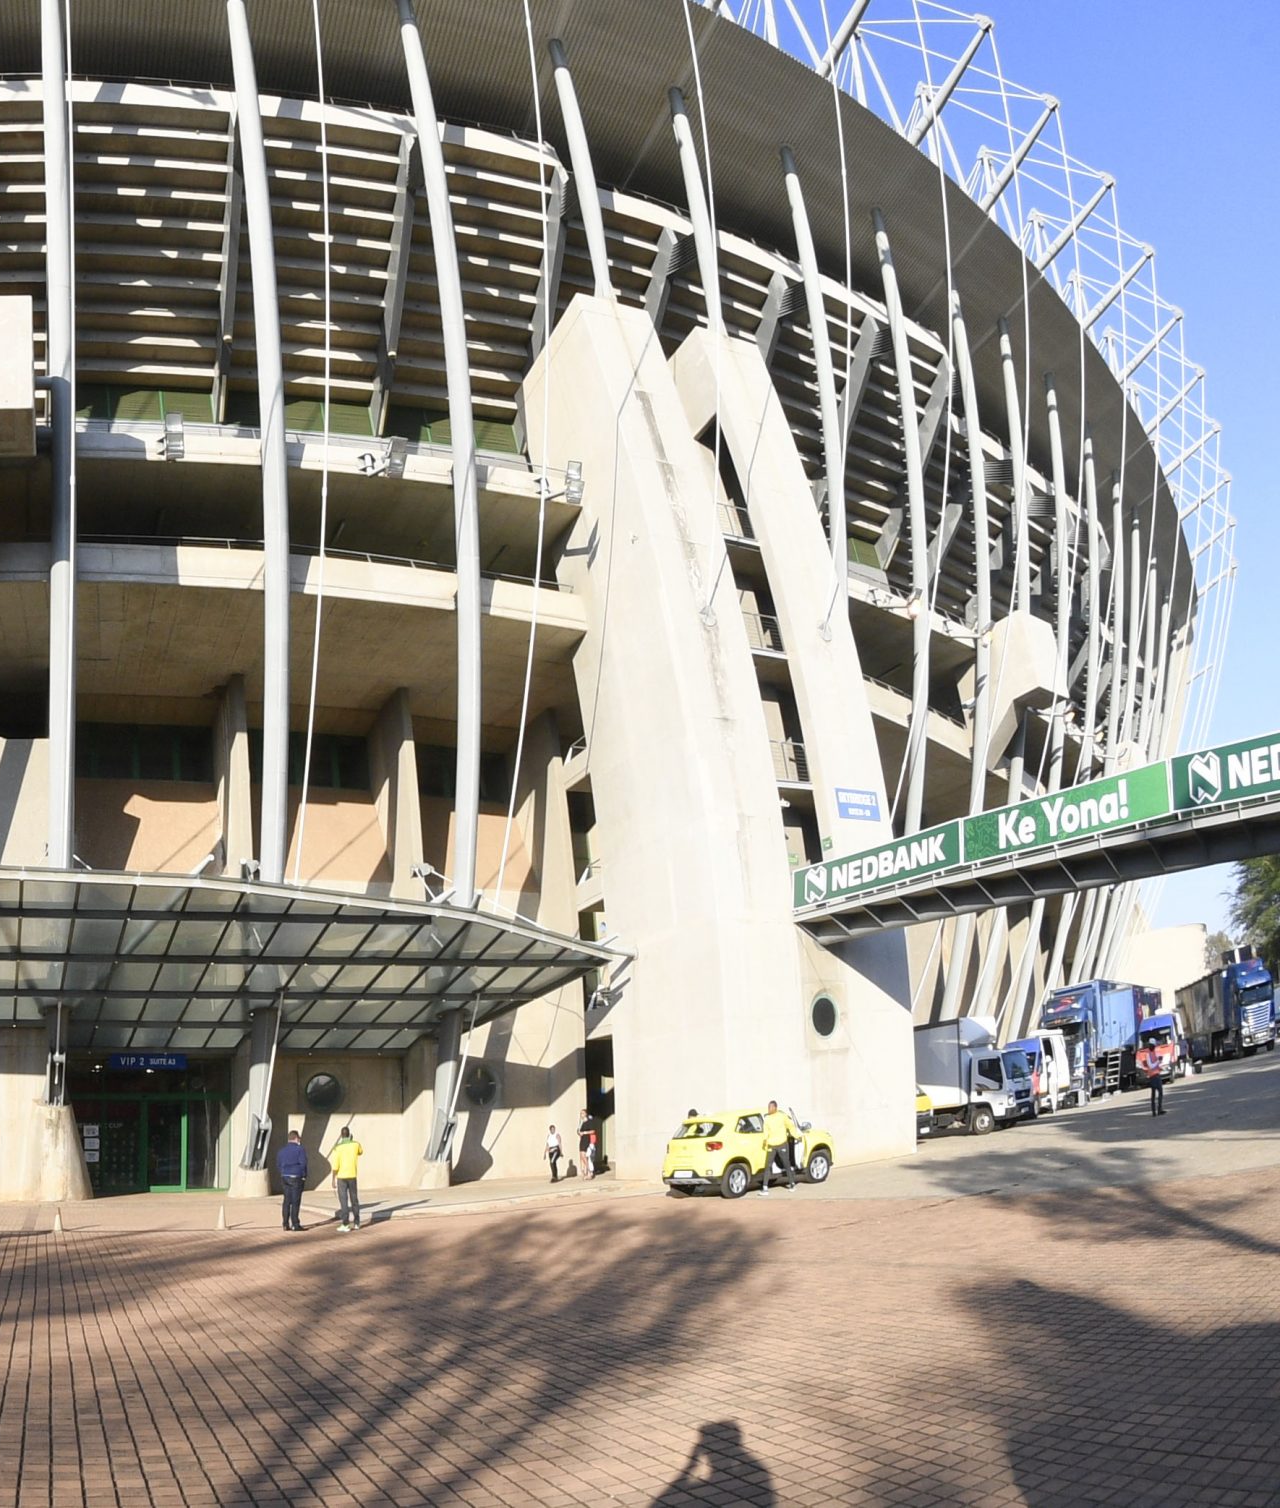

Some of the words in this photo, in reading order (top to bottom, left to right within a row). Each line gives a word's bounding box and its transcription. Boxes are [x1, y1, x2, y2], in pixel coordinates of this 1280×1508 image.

[998, 809, 1036, 849] Ke
[1040, 779, 1129, 836] Yona!
[831, 833, 946, 892] NEDBANK
[120, 1057, 136, 1066] VIP
[139, 1057, 145, 1066] 2
